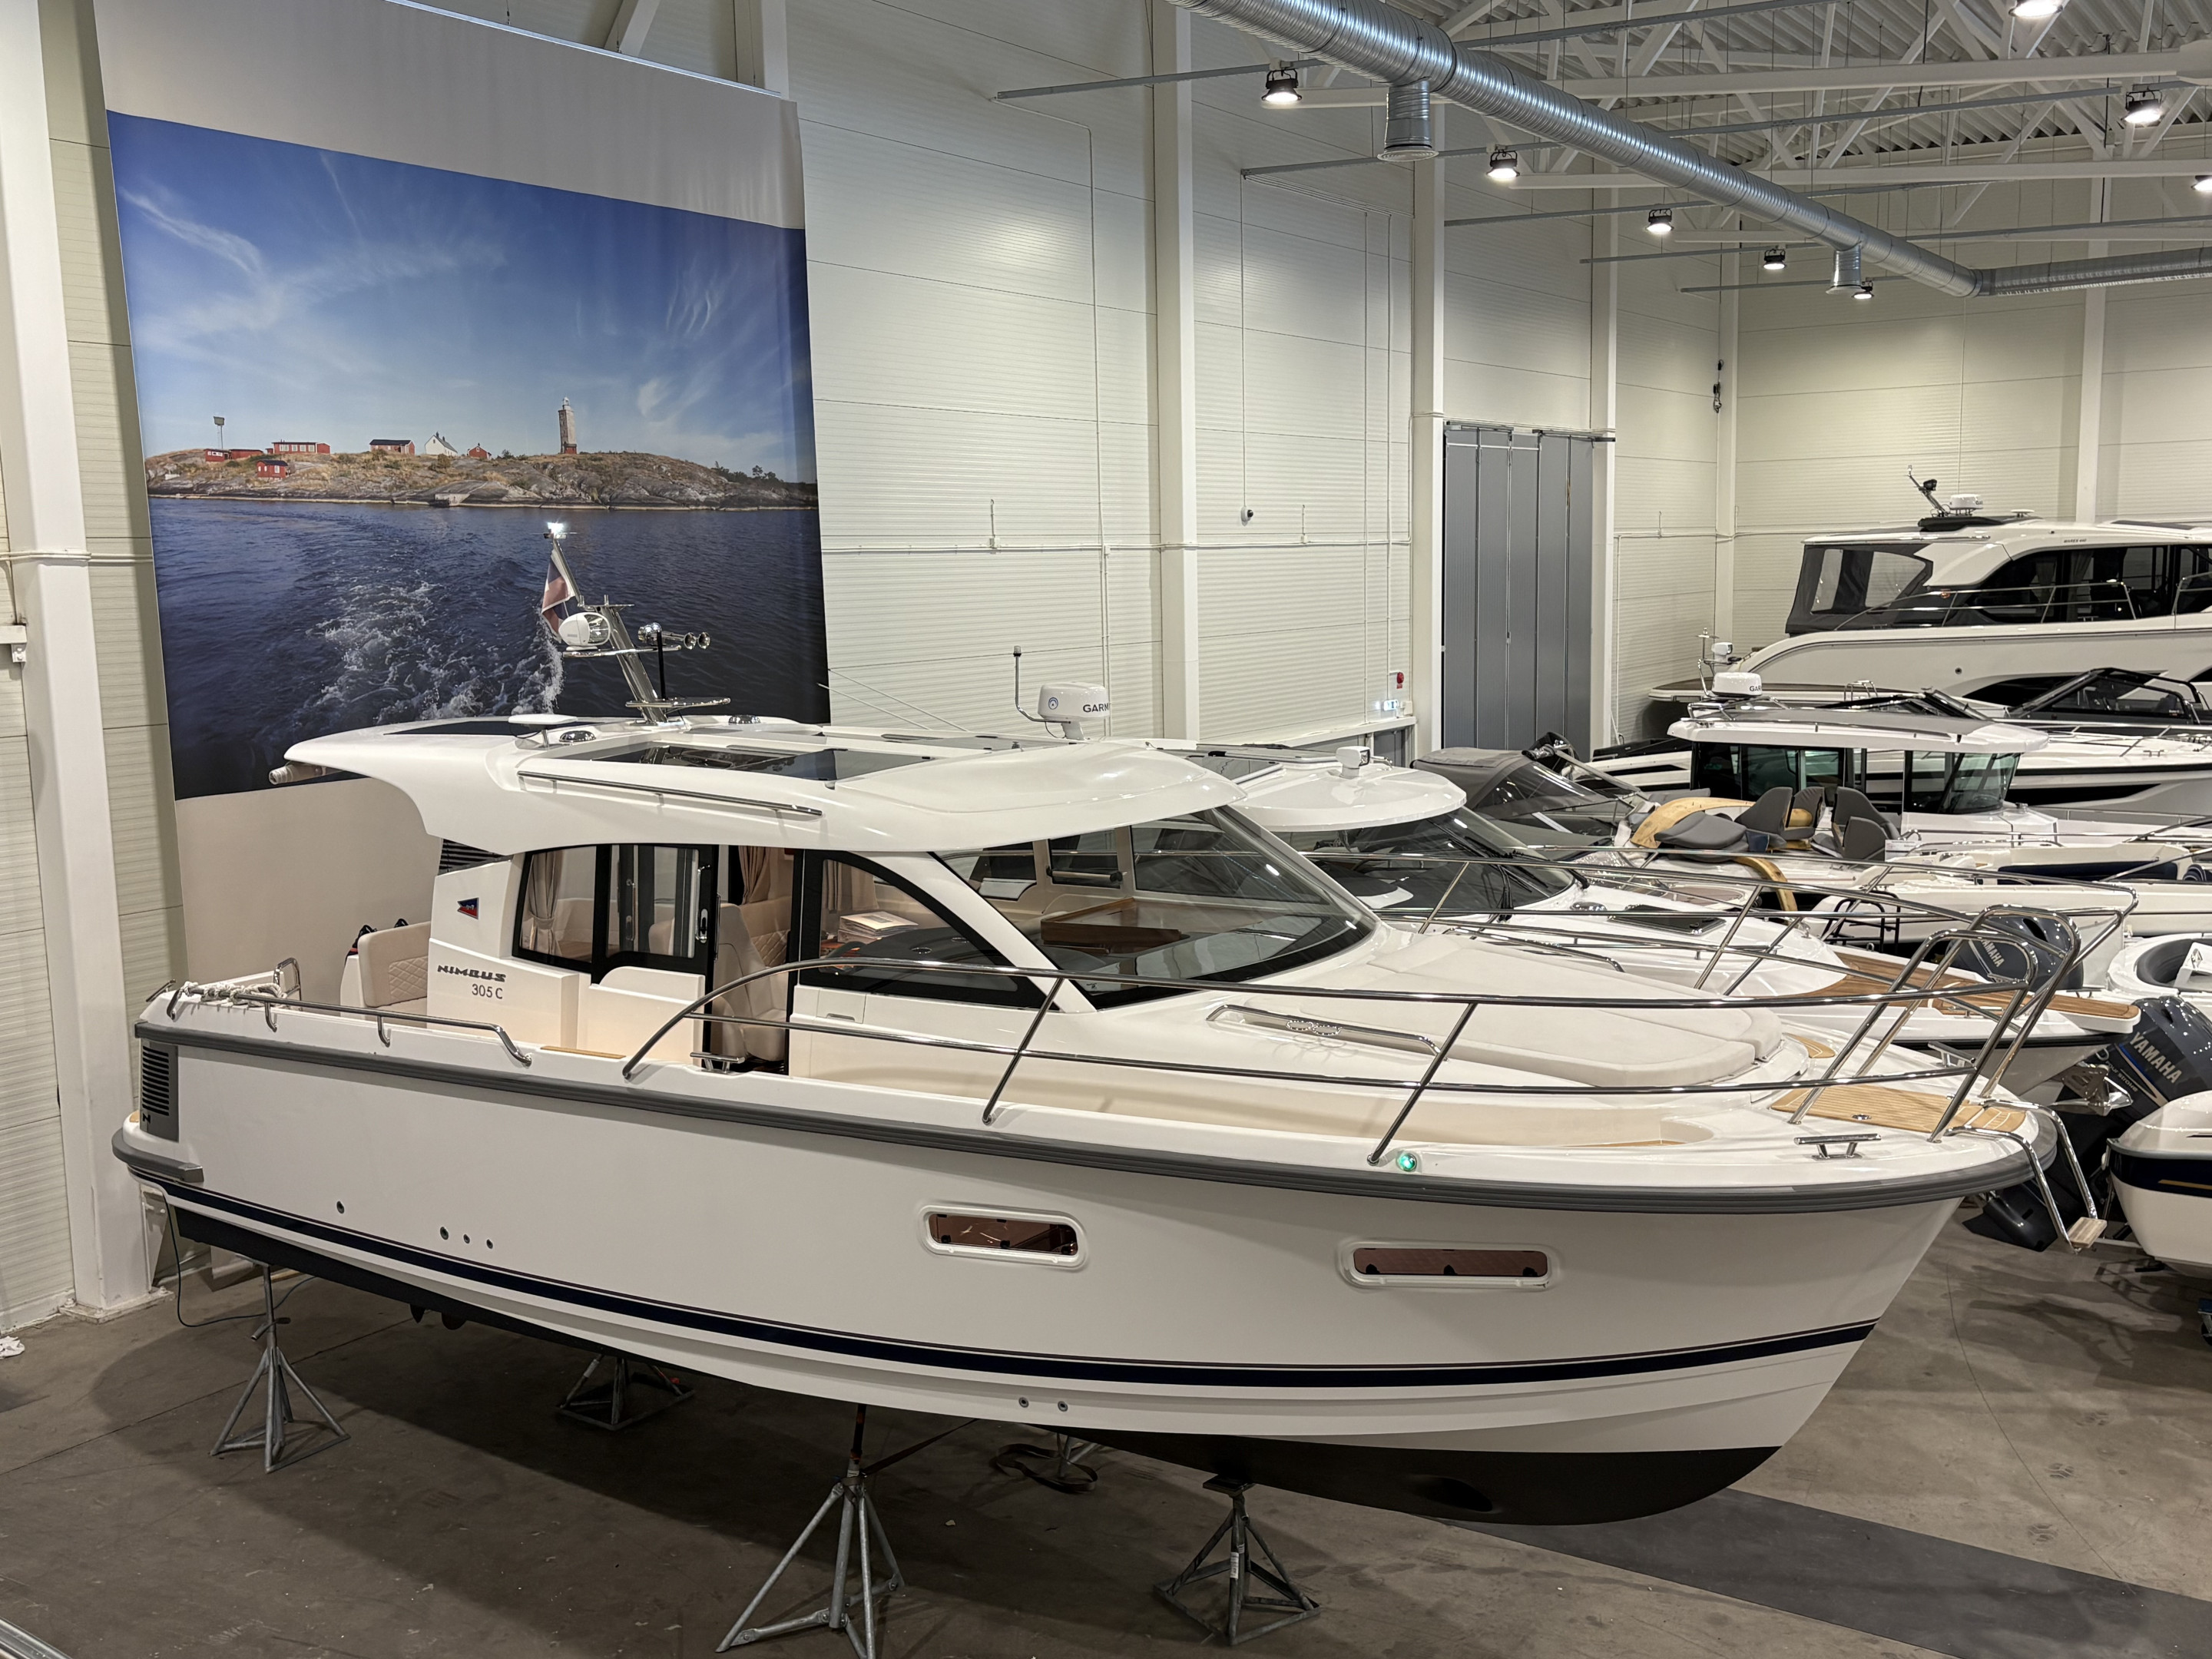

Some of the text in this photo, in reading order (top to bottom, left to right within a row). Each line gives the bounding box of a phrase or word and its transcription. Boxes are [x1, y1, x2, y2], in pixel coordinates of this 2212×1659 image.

[1982, 939, 2005, 968] AMAHA
[437, 965, 506, 982] NIMBUS
[472, 983, 503, 999] 305 C
[2129, 1031, 2182, 1084] YAMAHA
